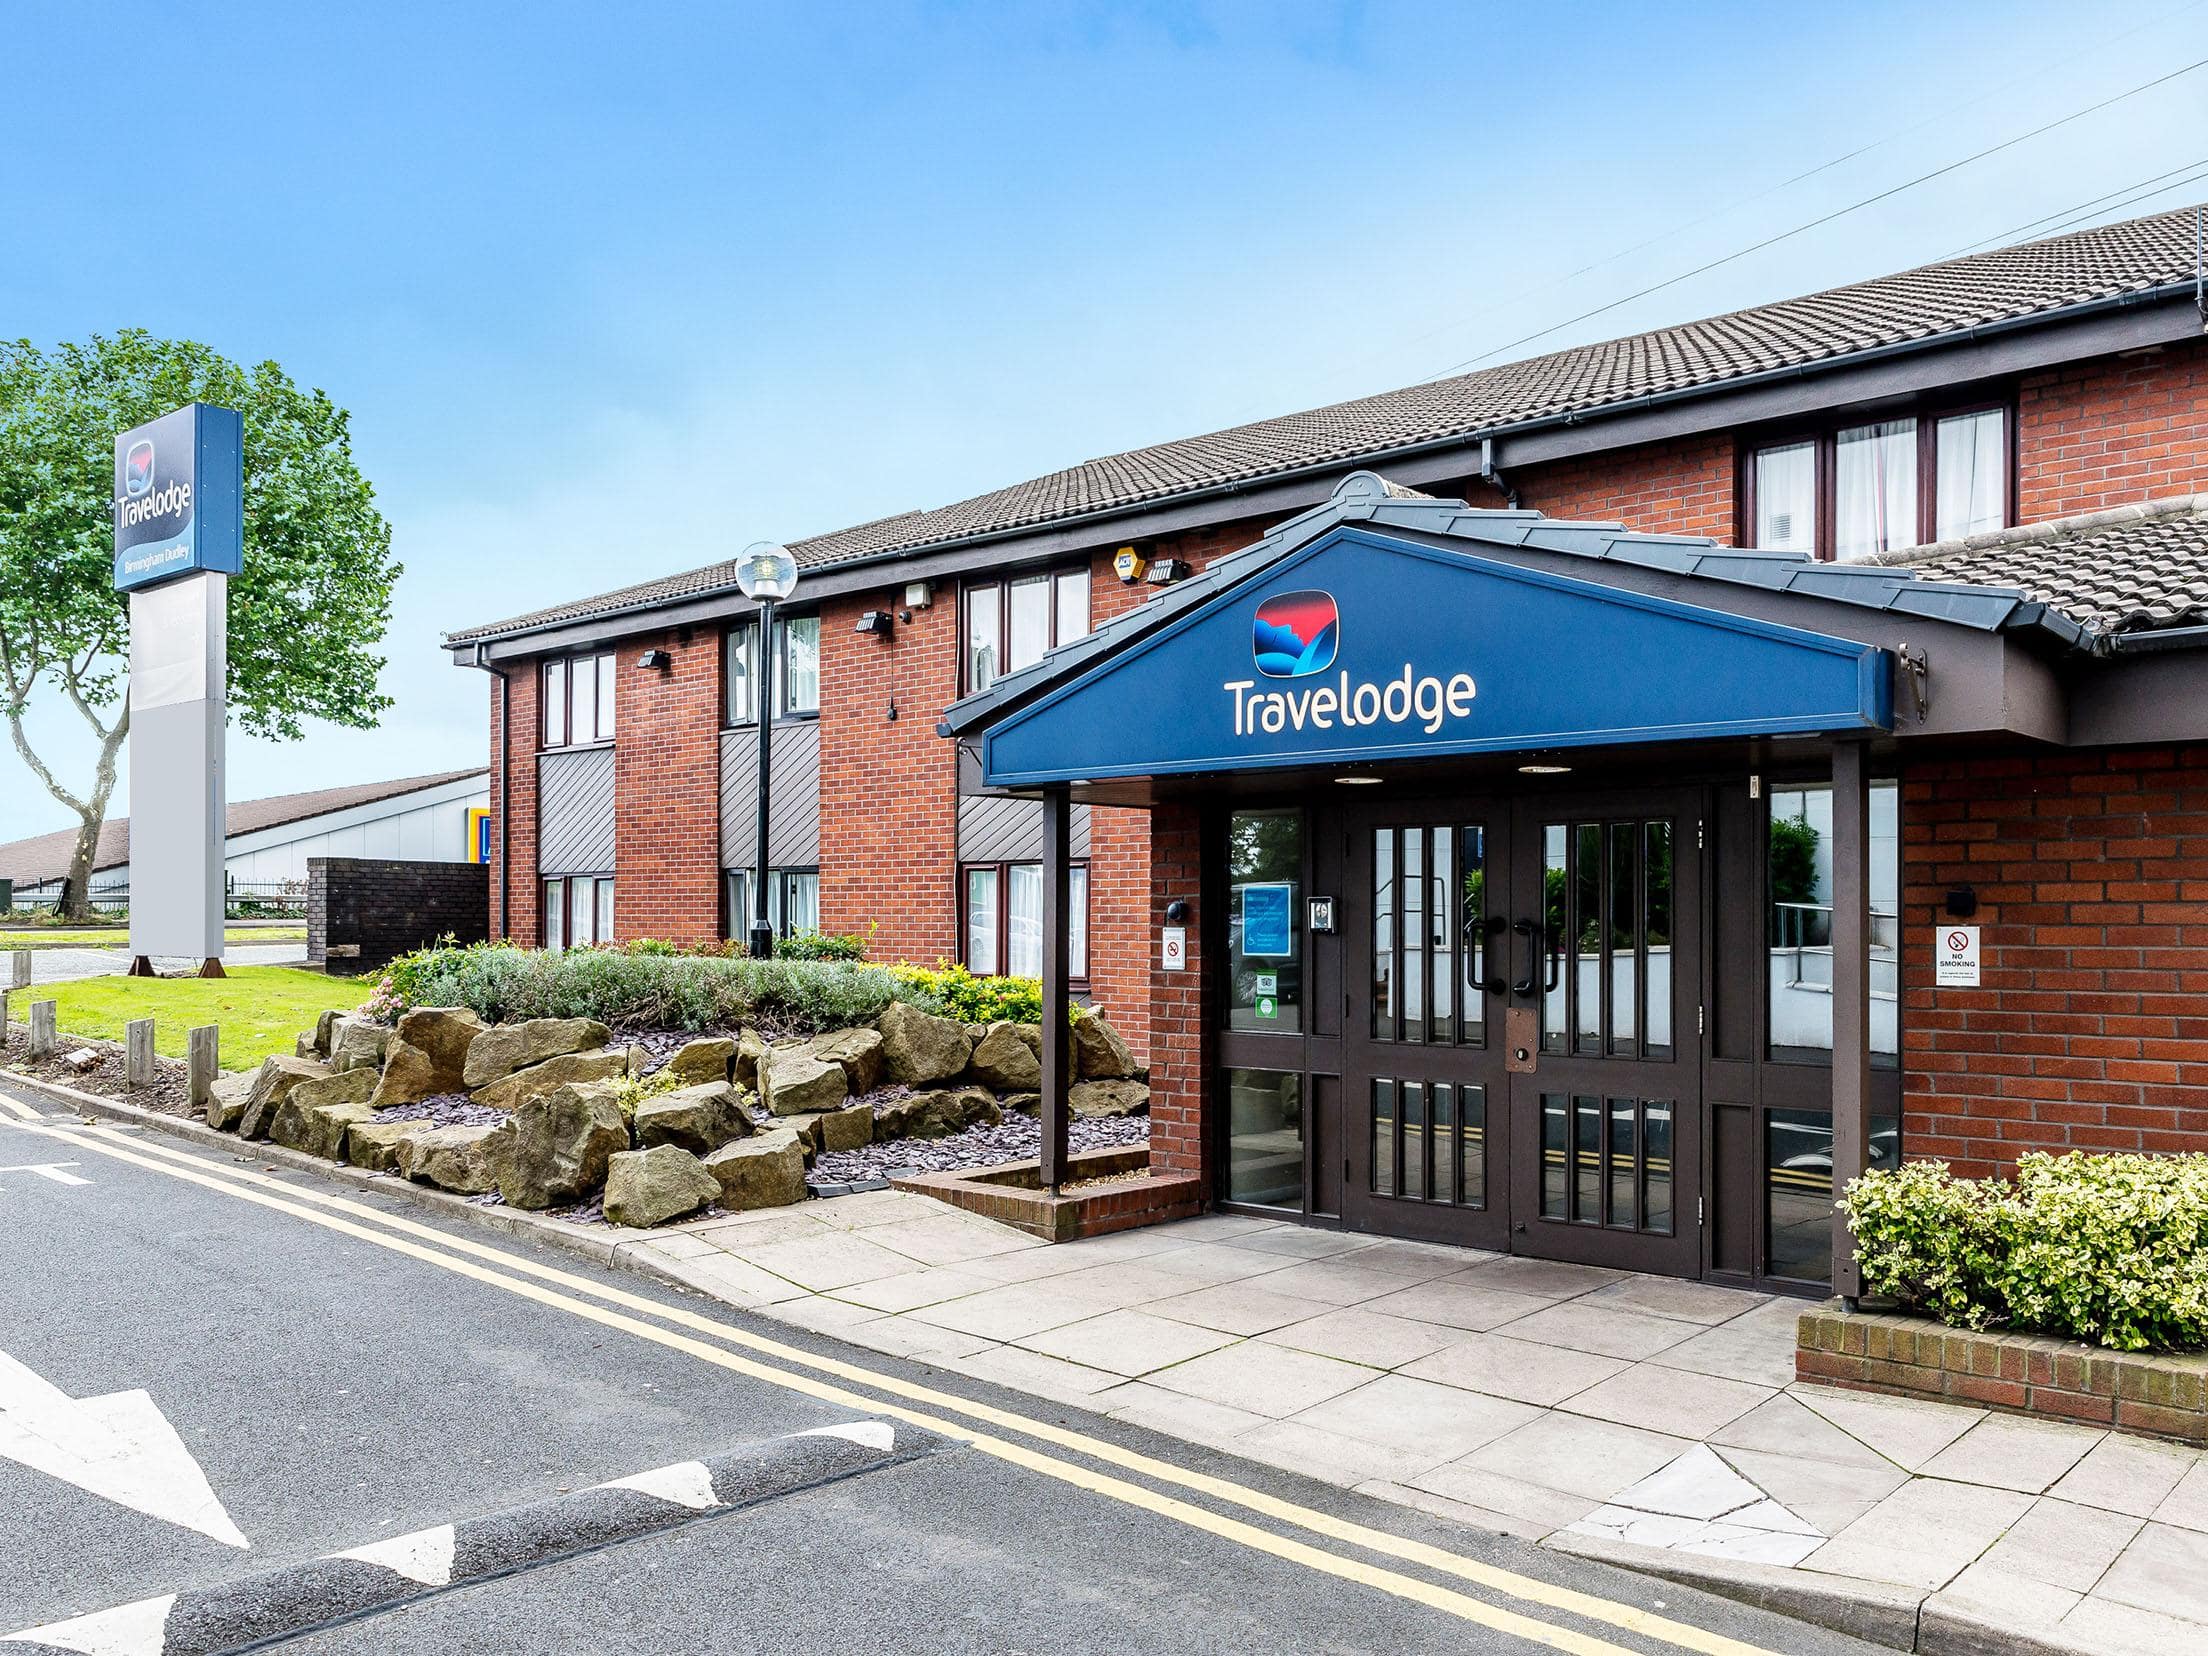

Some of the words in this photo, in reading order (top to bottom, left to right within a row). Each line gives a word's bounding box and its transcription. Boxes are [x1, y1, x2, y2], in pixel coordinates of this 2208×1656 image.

[118, 480, 191, 528] Travelodge
[125, 553, 164, 574] Birmingham
[165, 543, 189, 560] Dudley
[1223, 663, 1476, 736] Travelodge
